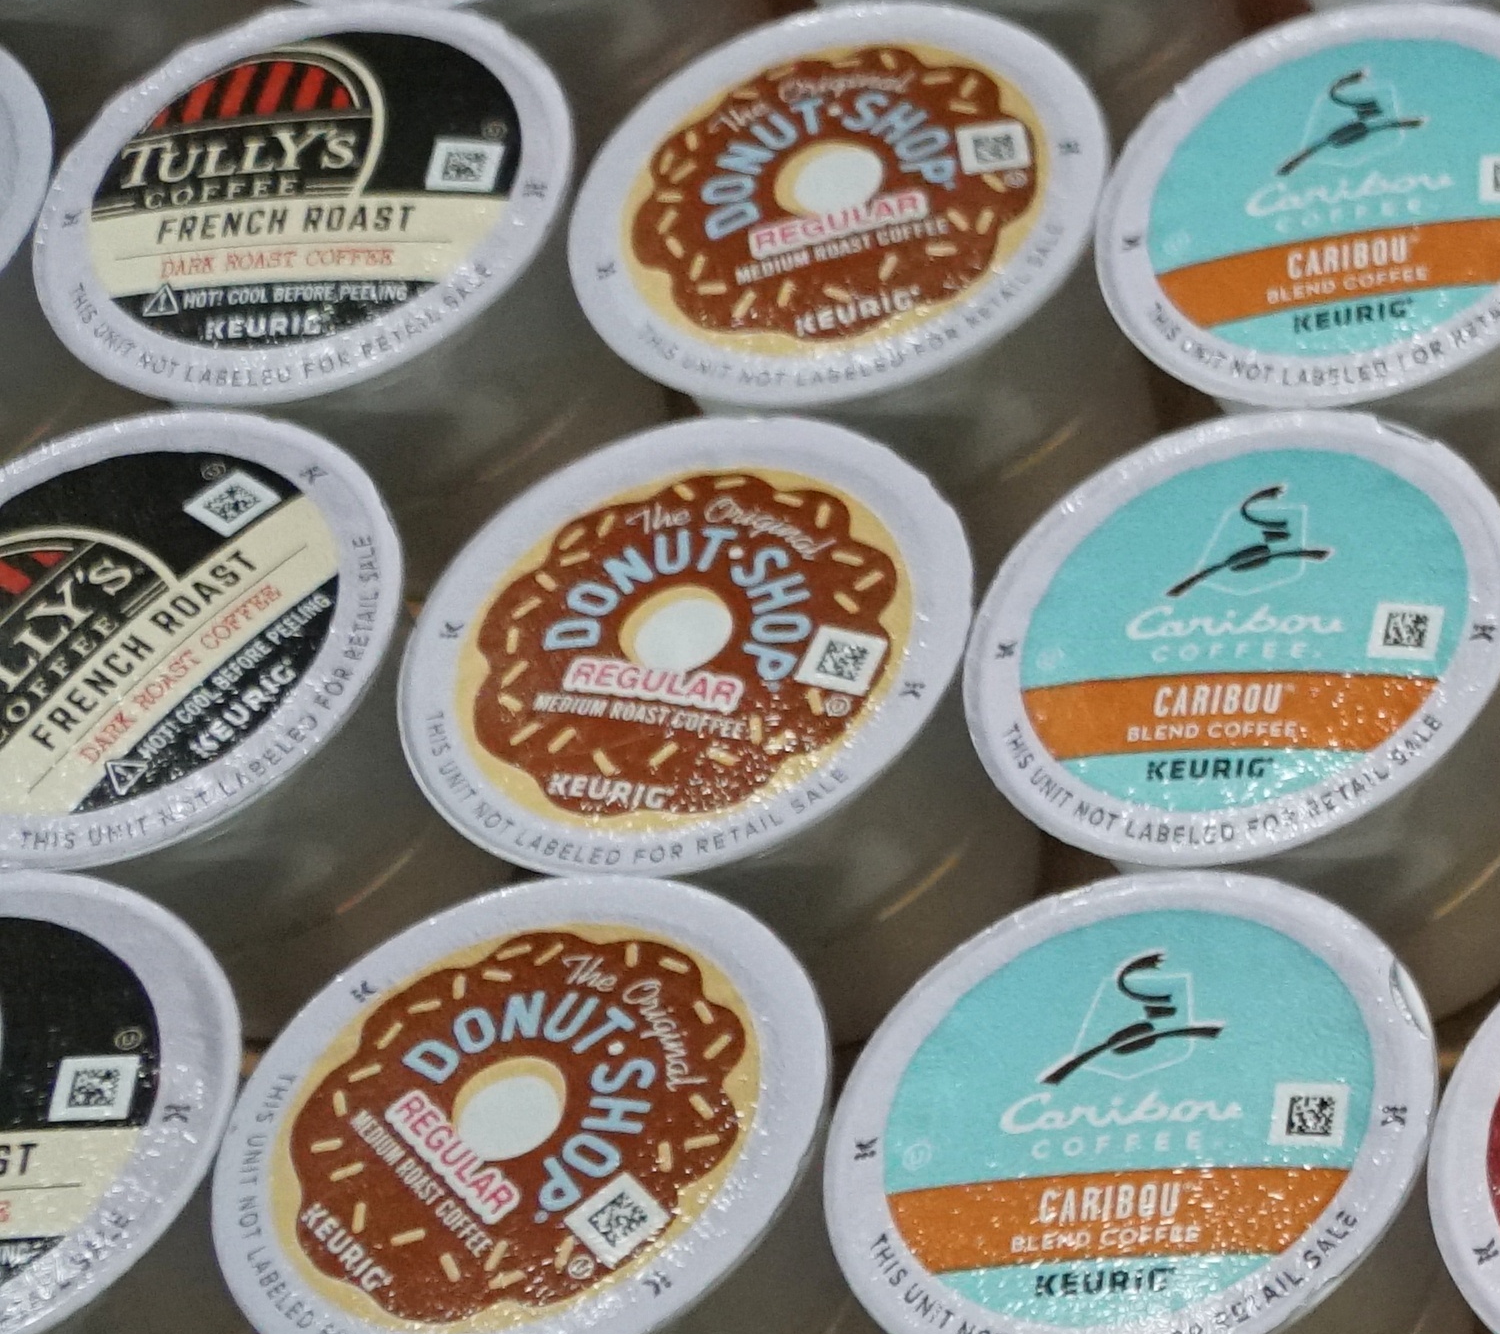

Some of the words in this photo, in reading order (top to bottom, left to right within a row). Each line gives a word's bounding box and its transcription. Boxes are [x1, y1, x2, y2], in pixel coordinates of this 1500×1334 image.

[120, 119, 357, 189] TULLY'S
[704, 95, 827, 242] DONUT
[850, 91, 962, 191] SHOP
[156, 205, 287, 244] FRENCH
[300, 201, 413, 235] ROAST
[752, 191, 923, 253] REGULAR
[1287, 236, 1409, 281] CARIBOU
[542, 529, 727, 650] DONUT
[737, 551, 812, 684] SHOP
[32, 631, 153, 752] FRENCH
[155, 551, 259, 637] ROAST
[570, 660, 739, 708] REGULAR
[1152, 683, 1284, 719] CARIBOU
[548, 773, 665, 810] KEURIG
[563, 953, 615, 993] The
[621, 978, 700, 1092] Original
[403, 989, 635, 1085] DONUT
[536, 1055, 655, 1216] SHOP
[395, 1093, 519, 1216] REGULAR
[1039, 1184, 1182, 1226] CARIBOU
[302, 1200, 383, 1292] KEURIG
